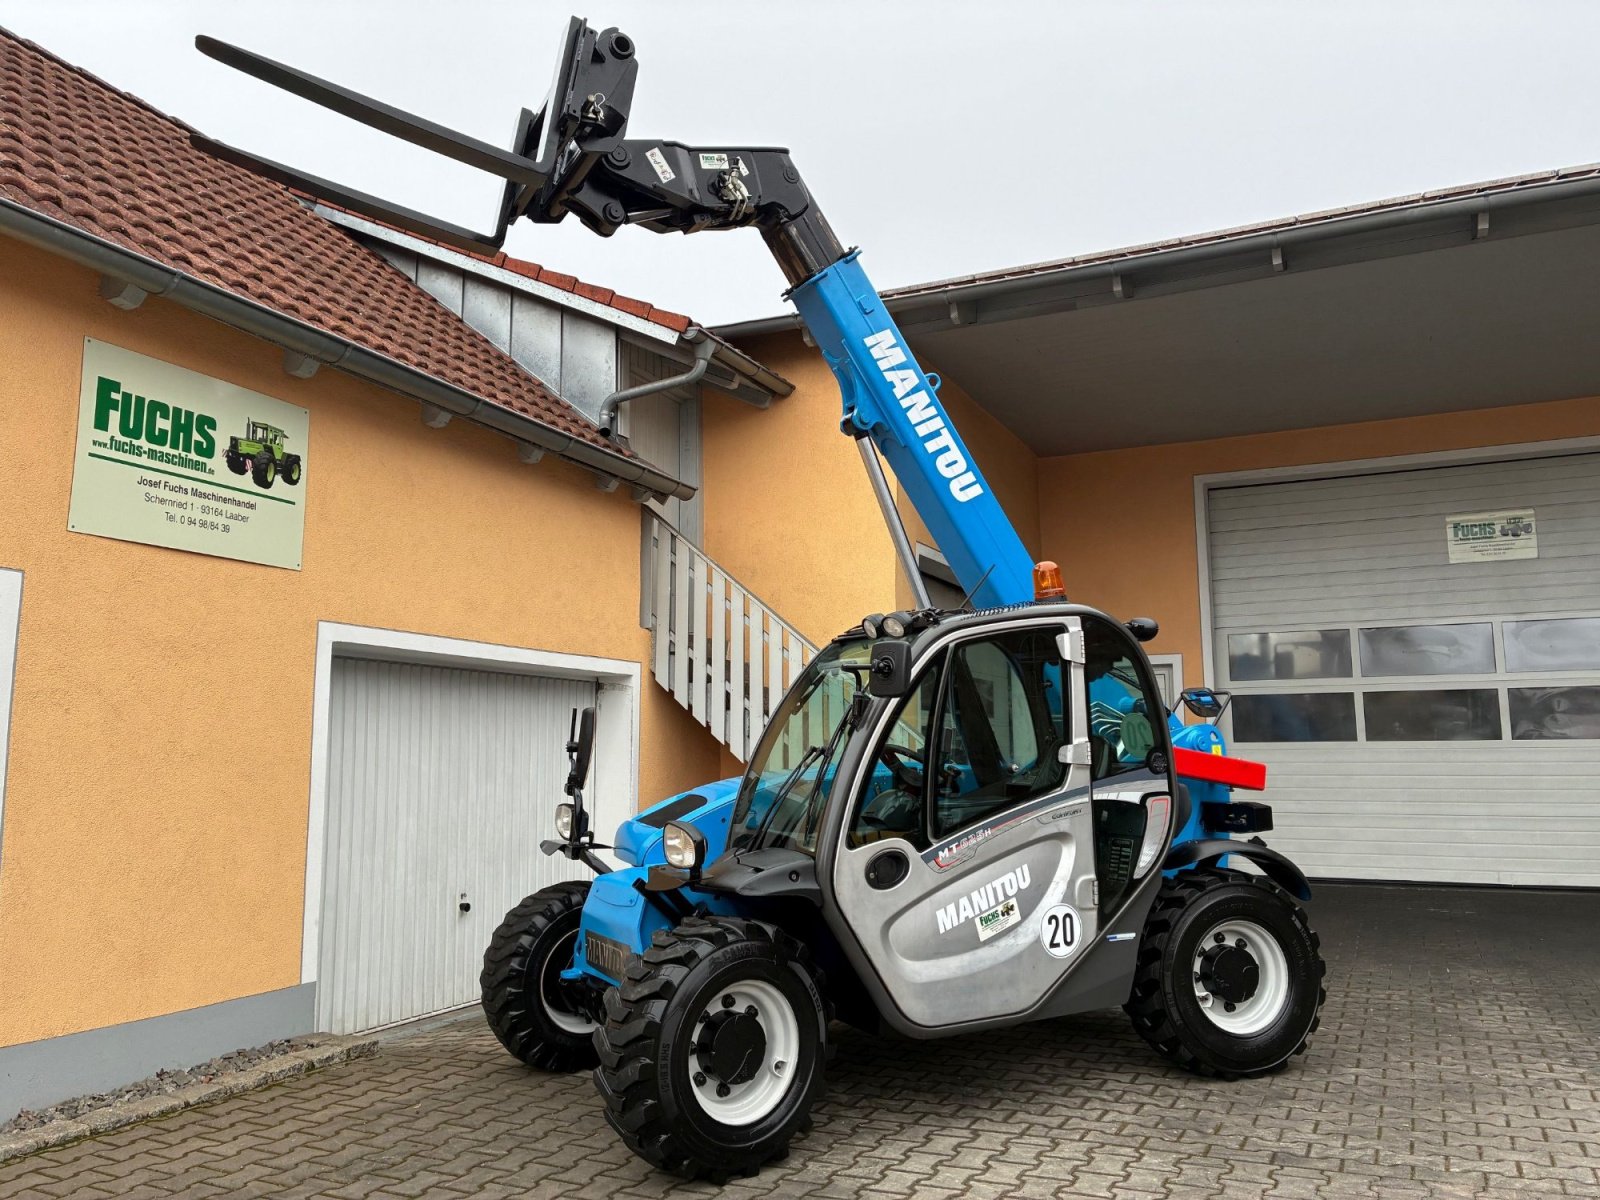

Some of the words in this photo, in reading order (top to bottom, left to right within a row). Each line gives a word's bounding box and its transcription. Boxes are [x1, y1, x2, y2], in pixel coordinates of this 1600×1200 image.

[93, 376, 218, 460] FUCHS
[863, 328, 984, 502] MANITOU
[137, 475, 162, 489] Josef
[163, 481, 189, 496] Fuchs
[190, 487, 257, 511] Maschinenhandel
[144, 492, 188, 510] Schernried
[190, 502, 194, 512] 1
[200, 505, 224, 518] 93164
[225, 510, 250, 523] Laaber
[165, 511, 178, 524] Tel.
[180, 515, 186, 525] 0
[221, 524, 231, 534] 39
[1453, 522, 1496, 538] FUCHS
[935, 863, 1031, 934] MANITOU
[1047, 912, 1075, 949] 20
